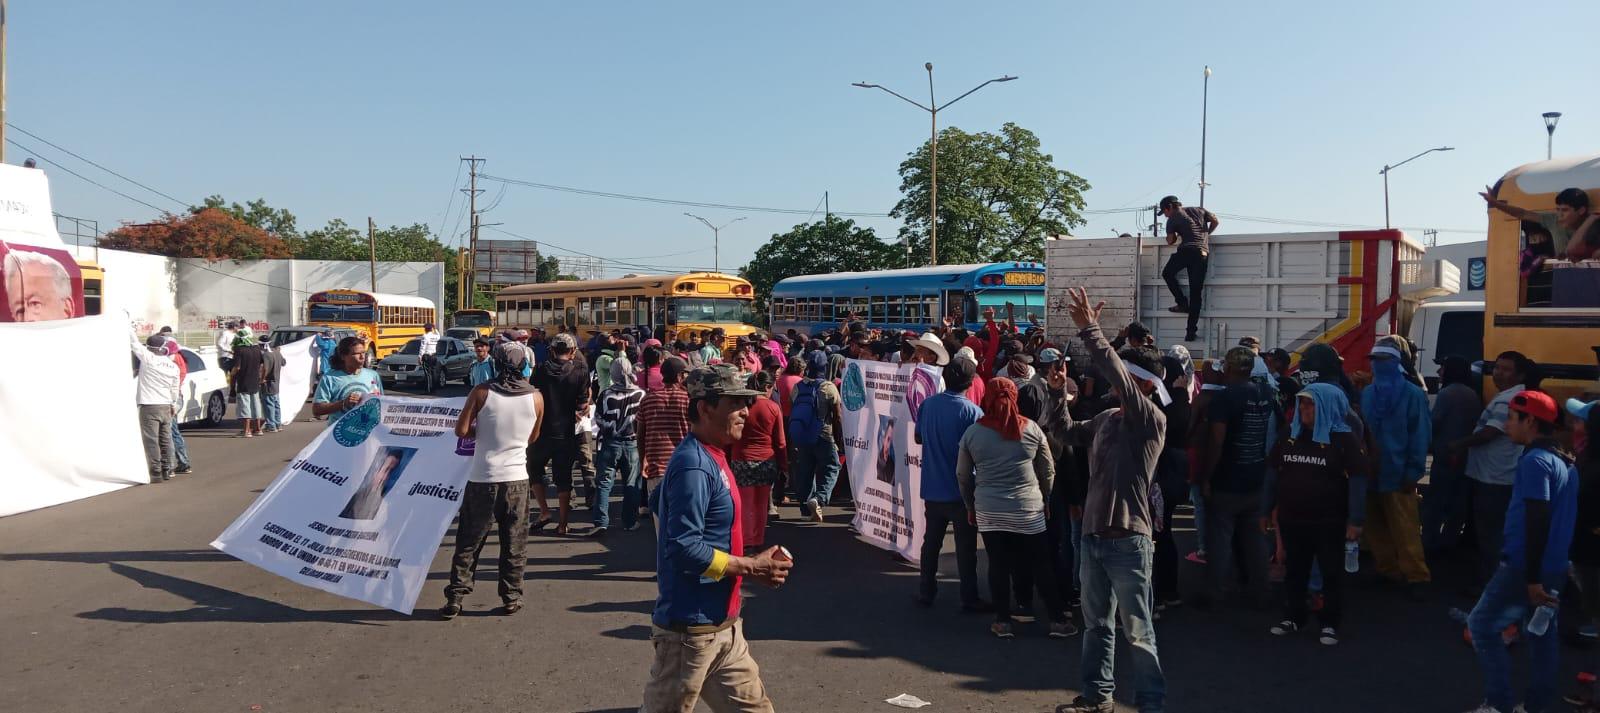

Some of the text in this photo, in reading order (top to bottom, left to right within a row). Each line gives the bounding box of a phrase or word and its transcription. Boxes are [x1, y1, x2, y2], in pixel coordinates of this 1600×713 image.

[1283, 455, 1326, 466] TASMANIA
[292, 459, 349, 487] ¡Justicia!
[264, 522, 297, 541] EJECUTADO
[293, 534, 303, 544] EL
[281, 543, 292, 553] DE
[289, 546, 300, 557] LA
